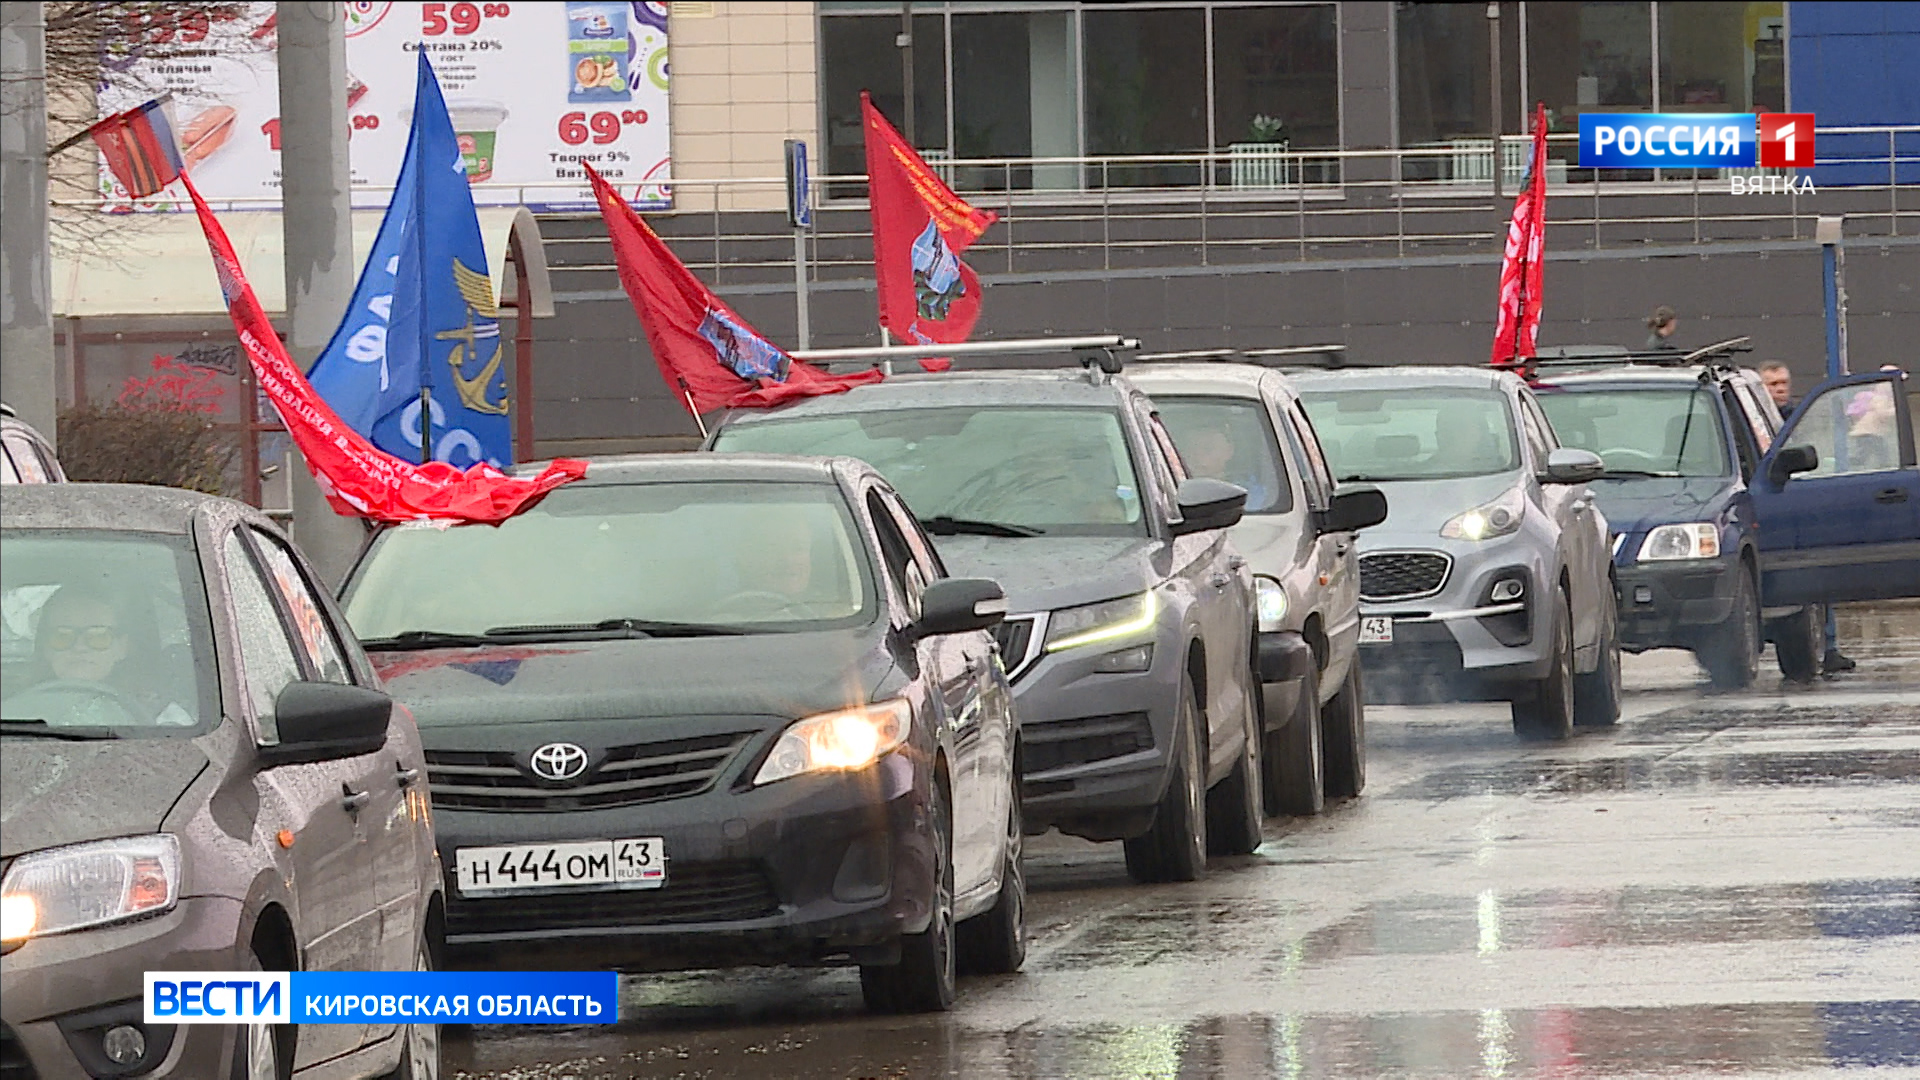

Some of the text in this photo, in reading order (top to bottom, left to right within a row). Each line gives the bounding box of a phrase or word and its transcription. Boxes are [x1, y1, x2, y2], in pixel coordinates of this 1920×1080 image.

[1365, 619, 1386, 634] 43
[618, 843, 650, 867] 43
[617, 868, 642, 878] RUS
